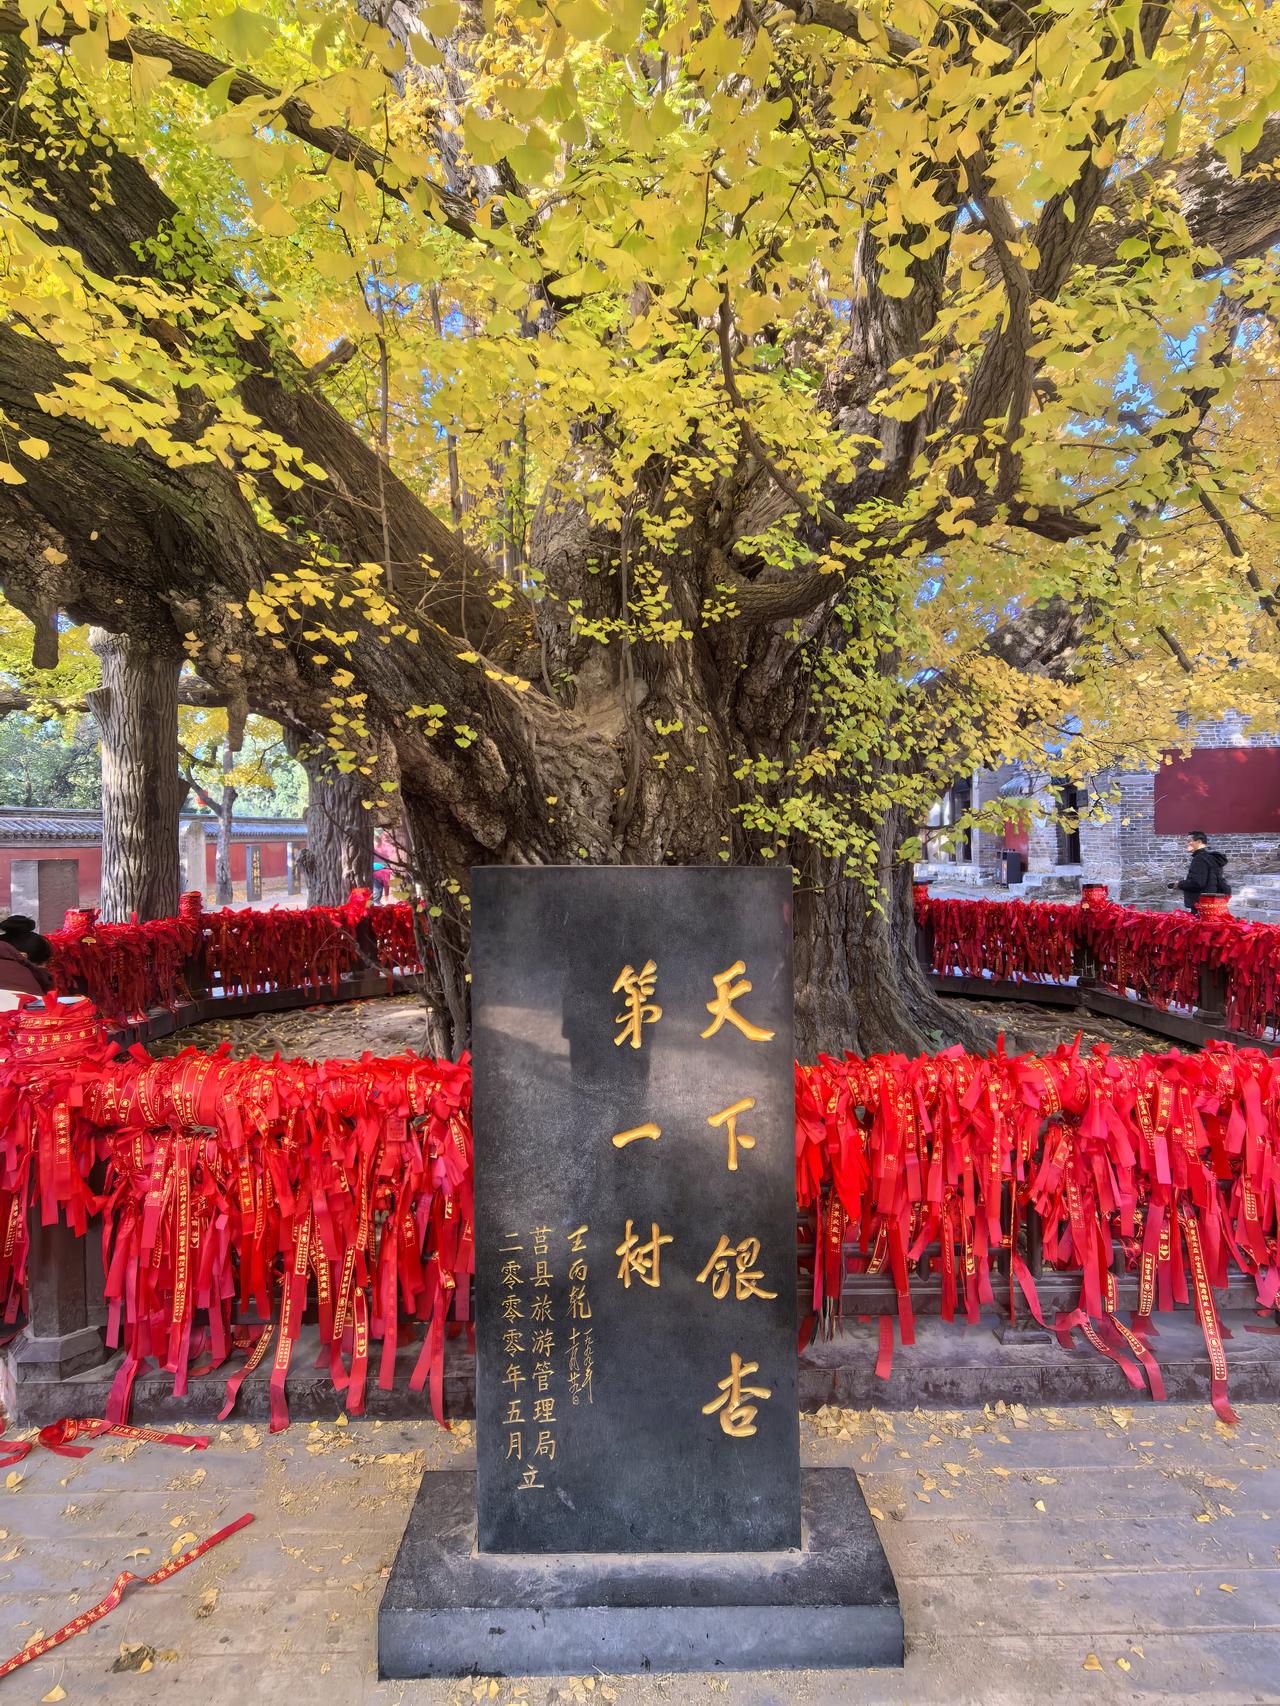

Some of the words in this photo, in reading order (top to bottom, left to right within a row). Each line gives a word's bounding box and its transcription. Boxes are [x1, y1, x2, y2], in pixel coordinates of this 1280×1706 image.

[499, 1232, 527, 1461] 二零零零年五月
[529, 1226, 558, 1461] 莒县旅游管理局
[516, 1464, 546, 1490] 立
